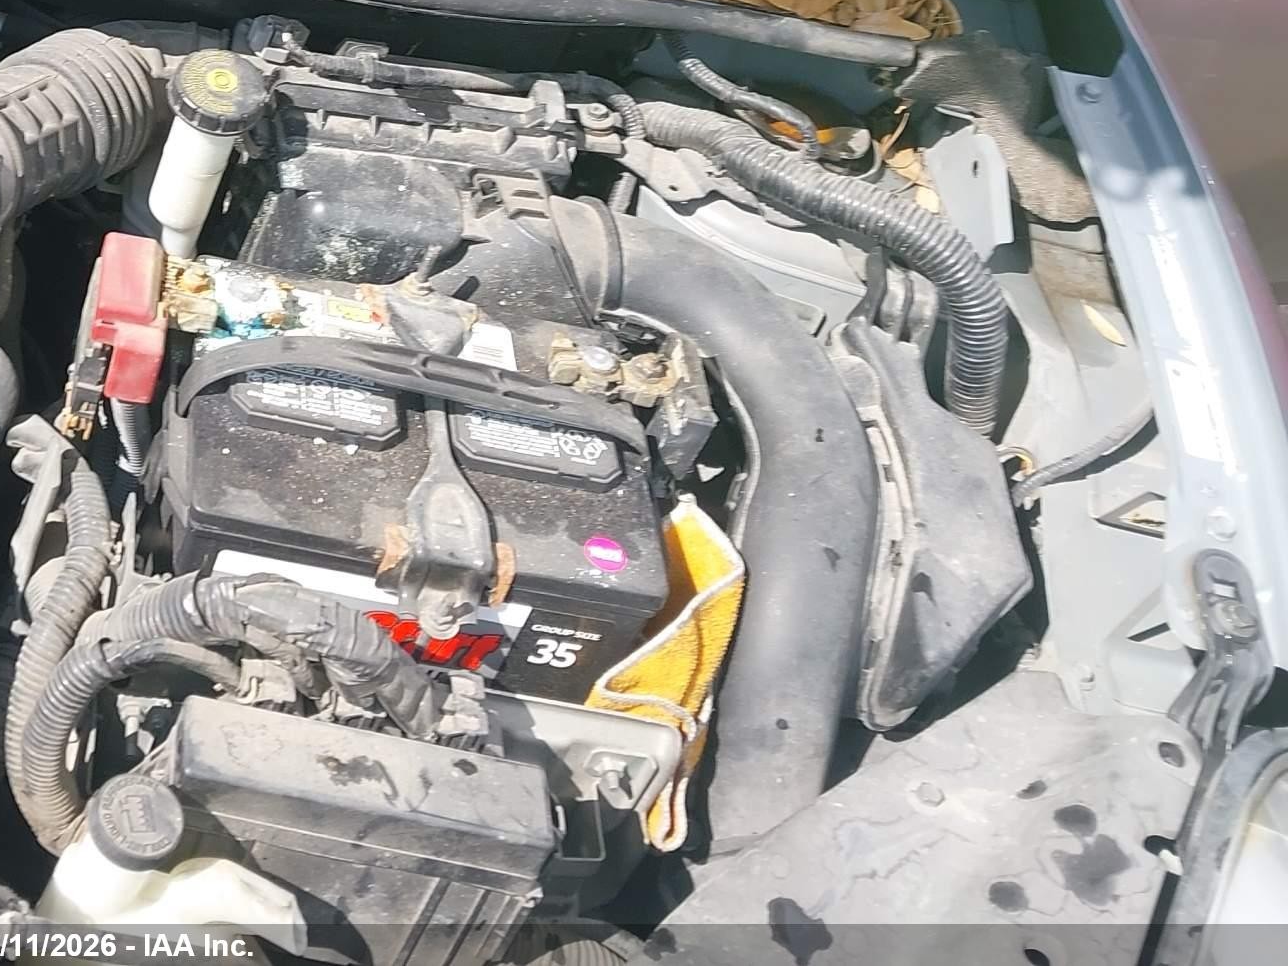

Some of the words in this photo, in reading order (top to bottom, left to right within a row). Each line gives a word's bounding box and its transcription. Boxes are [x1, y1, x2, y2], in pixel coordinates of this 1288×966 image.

[531, 624, 575, 636] GROUP
[574, 631, 603, 641] SIZE
[527, 638, 583, 668] 35
